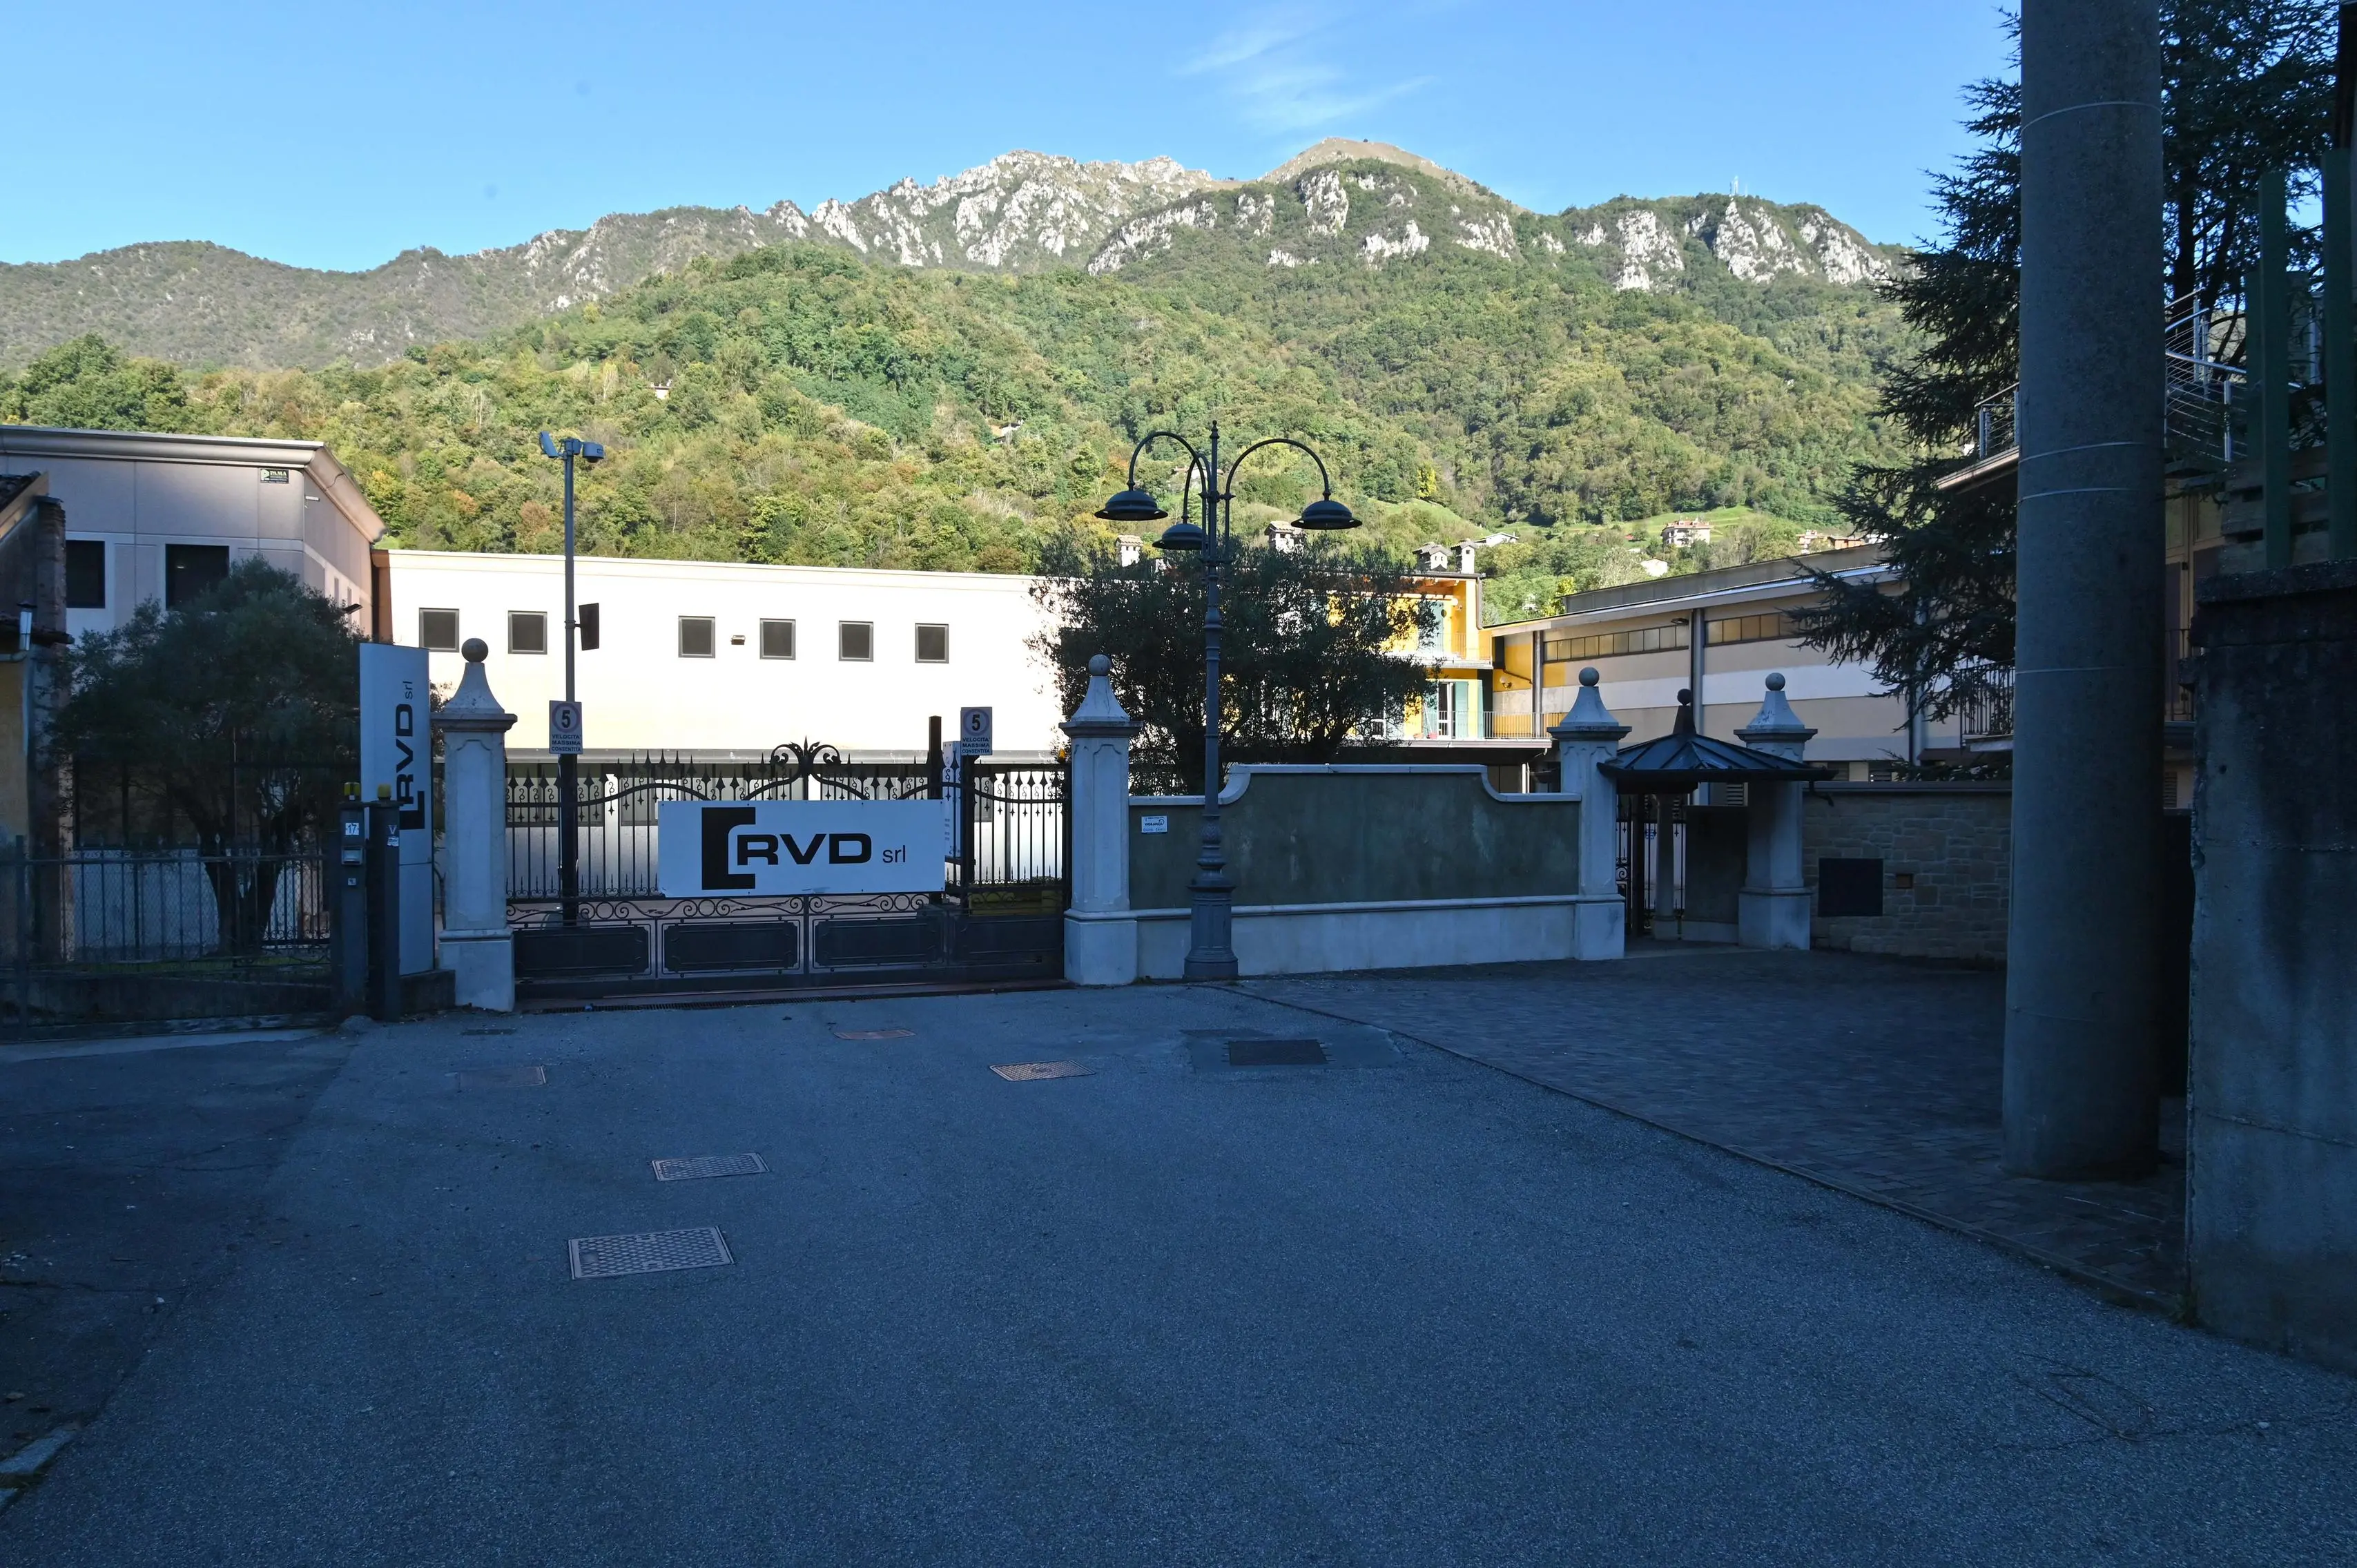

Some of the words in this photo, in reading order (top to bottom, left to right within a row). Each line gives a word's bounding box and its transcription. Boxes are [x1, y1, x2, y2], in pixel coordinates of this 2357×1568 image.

[402, 681, 413, 699] srl
[561, 710, 571, 728] 5
[971, 714, 980, 731] 5
[396, 704, 414, 804] RVD
[347, 824, 357, 834] 17
[737, 833, 872, 865] RVD
[882, 845, 906, 863] srl
